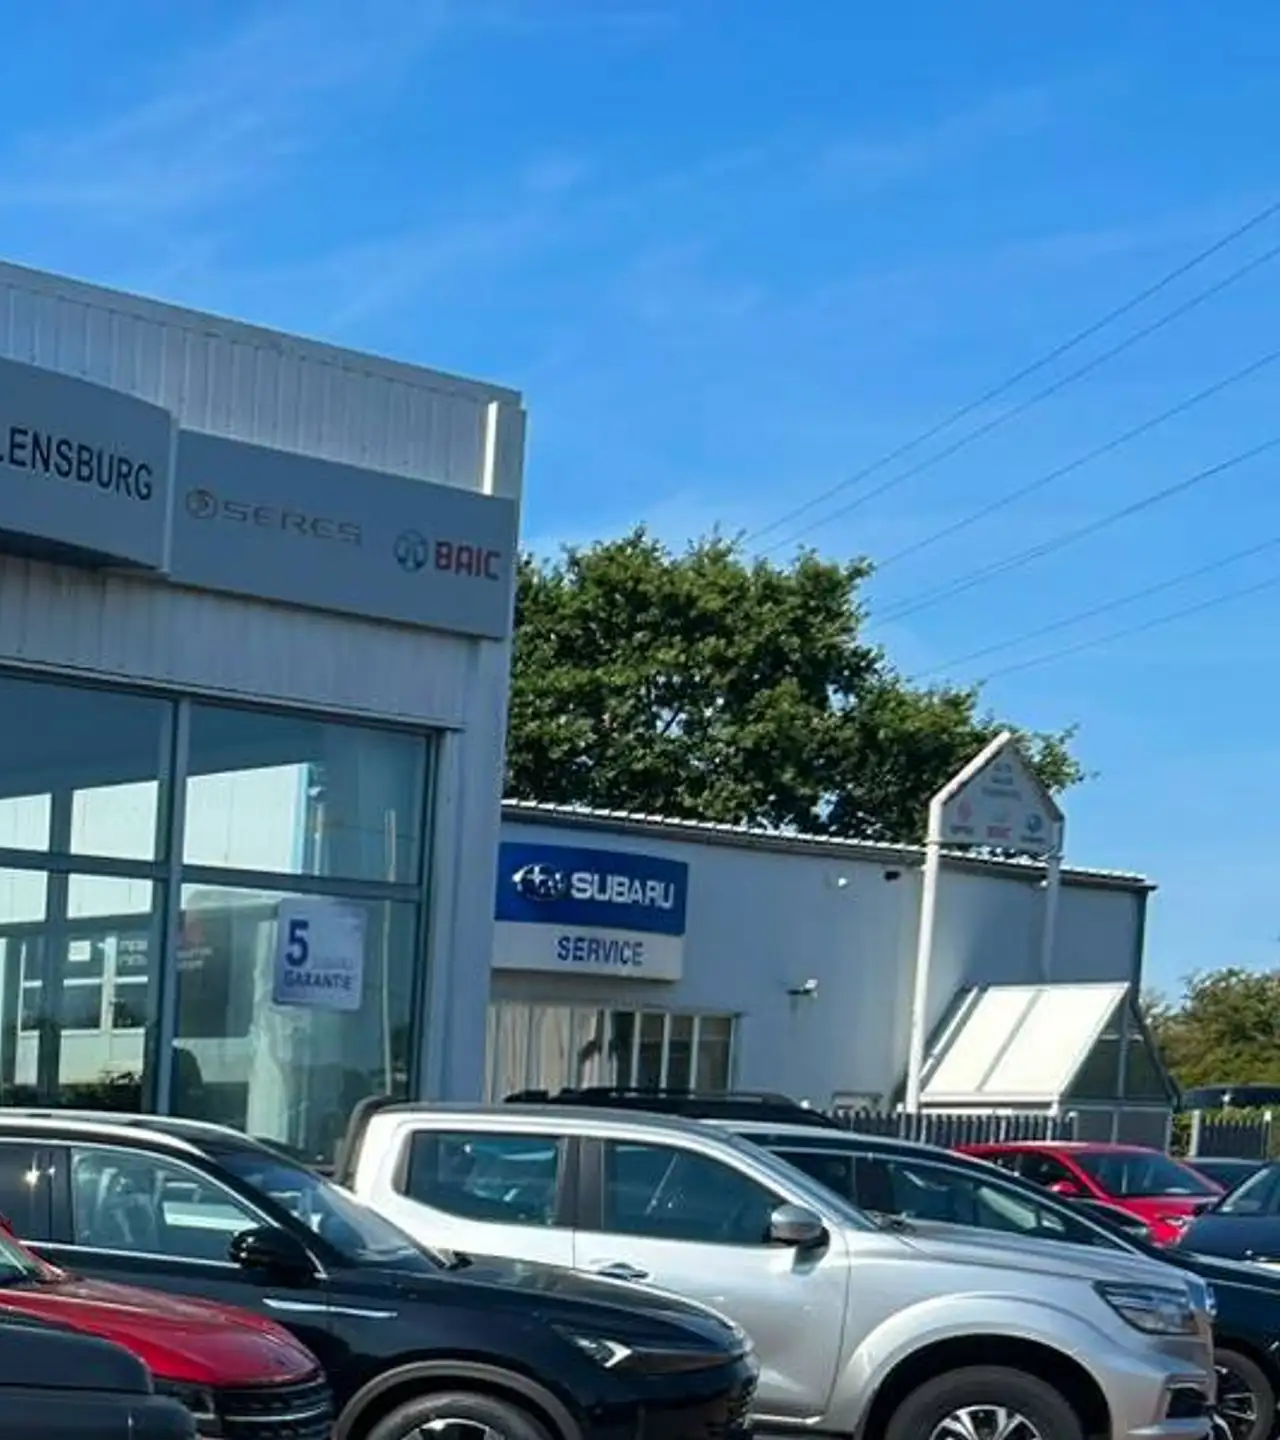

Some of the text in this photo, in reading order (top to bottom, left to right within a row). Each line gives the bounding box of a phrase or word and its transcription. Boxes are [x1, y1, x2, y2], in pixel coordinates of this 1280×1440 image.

[222, 503, 362, 546] SERES
[435, 541, 503, 581] BAIC
[571, 872, 675, 909] SUBARU
[285, 919, 310, 968] 5
[557, 936, 643, 967] SERVICE
